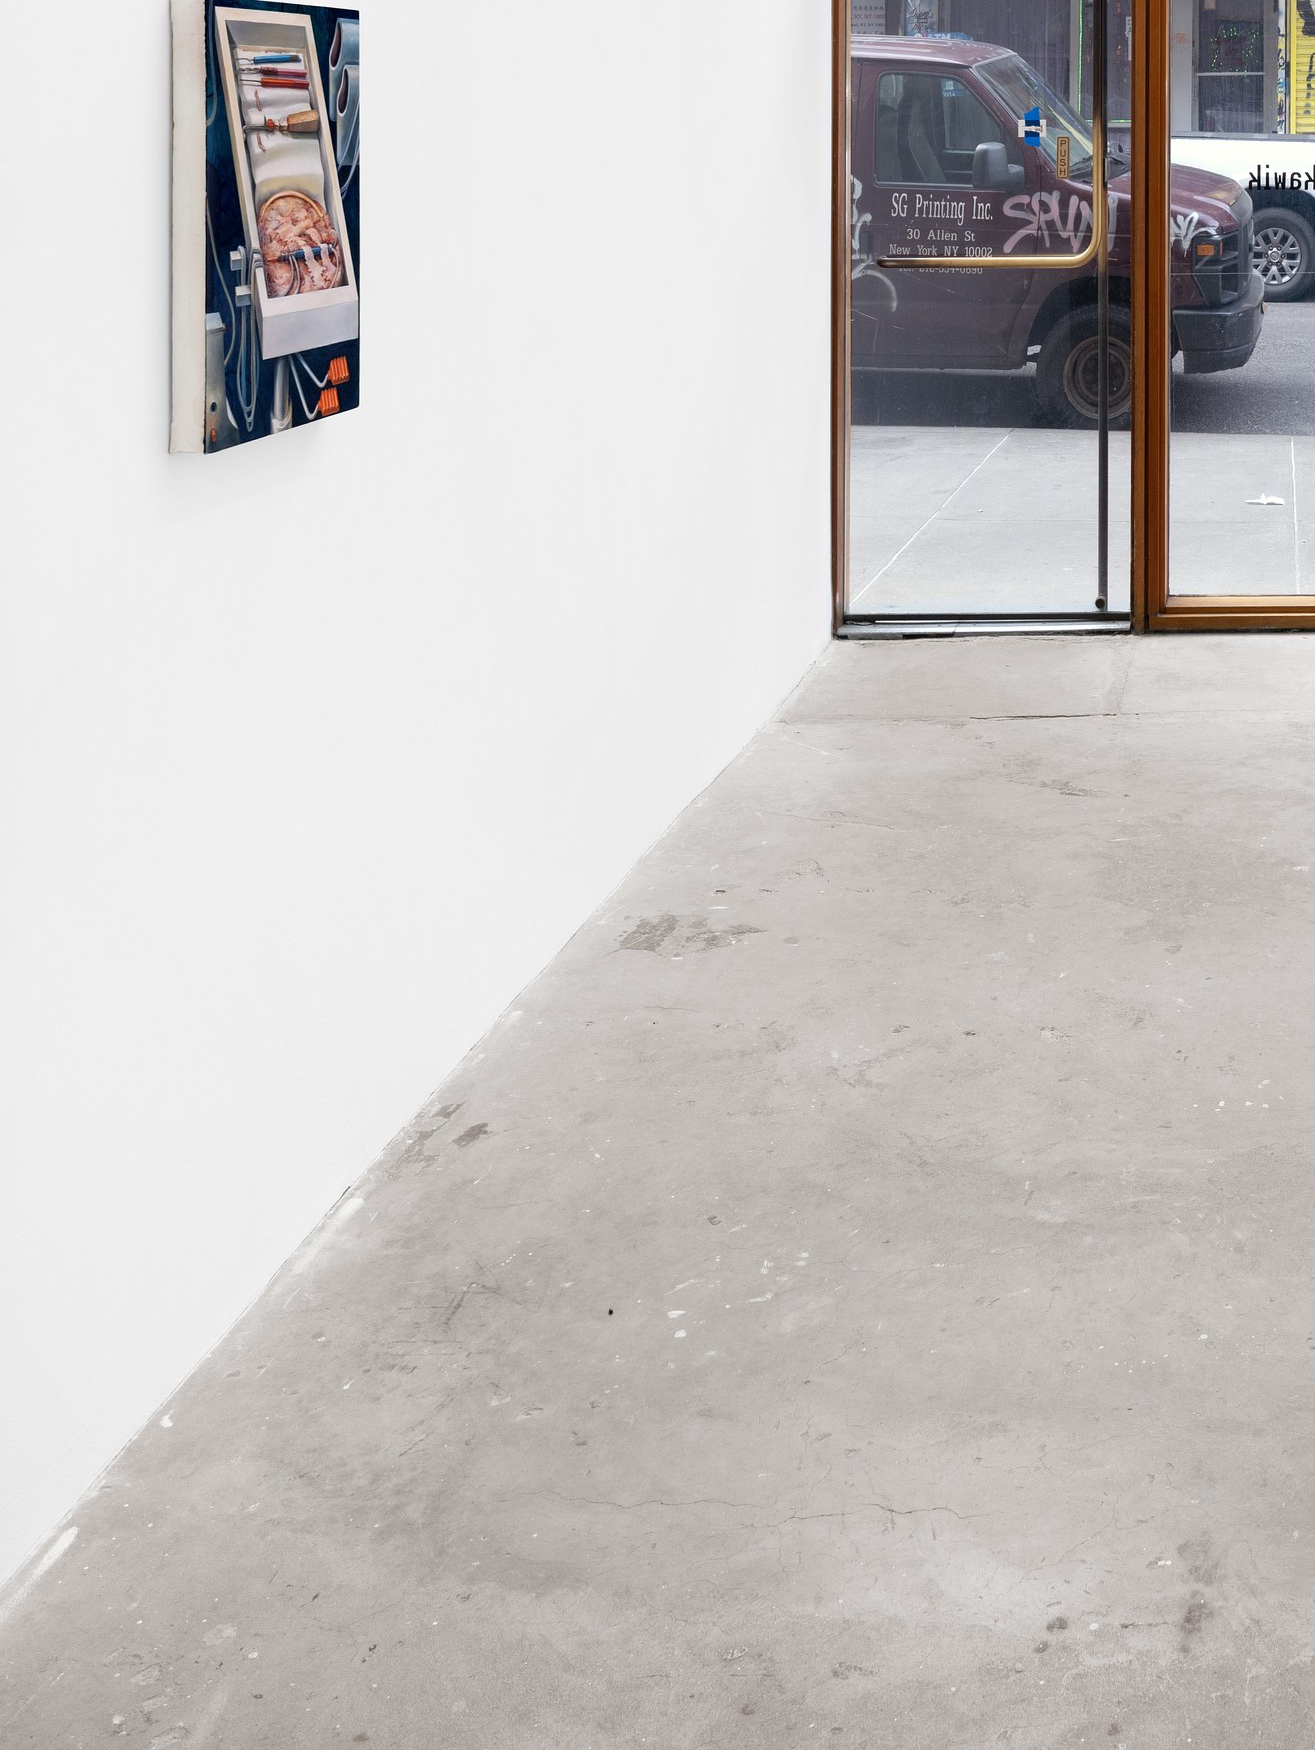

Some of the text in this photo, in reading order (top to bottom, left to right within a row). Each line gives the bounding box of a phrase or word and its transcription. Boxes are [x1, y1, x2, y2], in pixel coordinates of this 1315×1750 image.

[1059, 139, 1067, 176] PUSH
[891, 192, 994, 226] SG Printing Inc.
[906, 228, 976, 242] 30 Allen St
[889, 243, 993, 258] New York NY 10002
